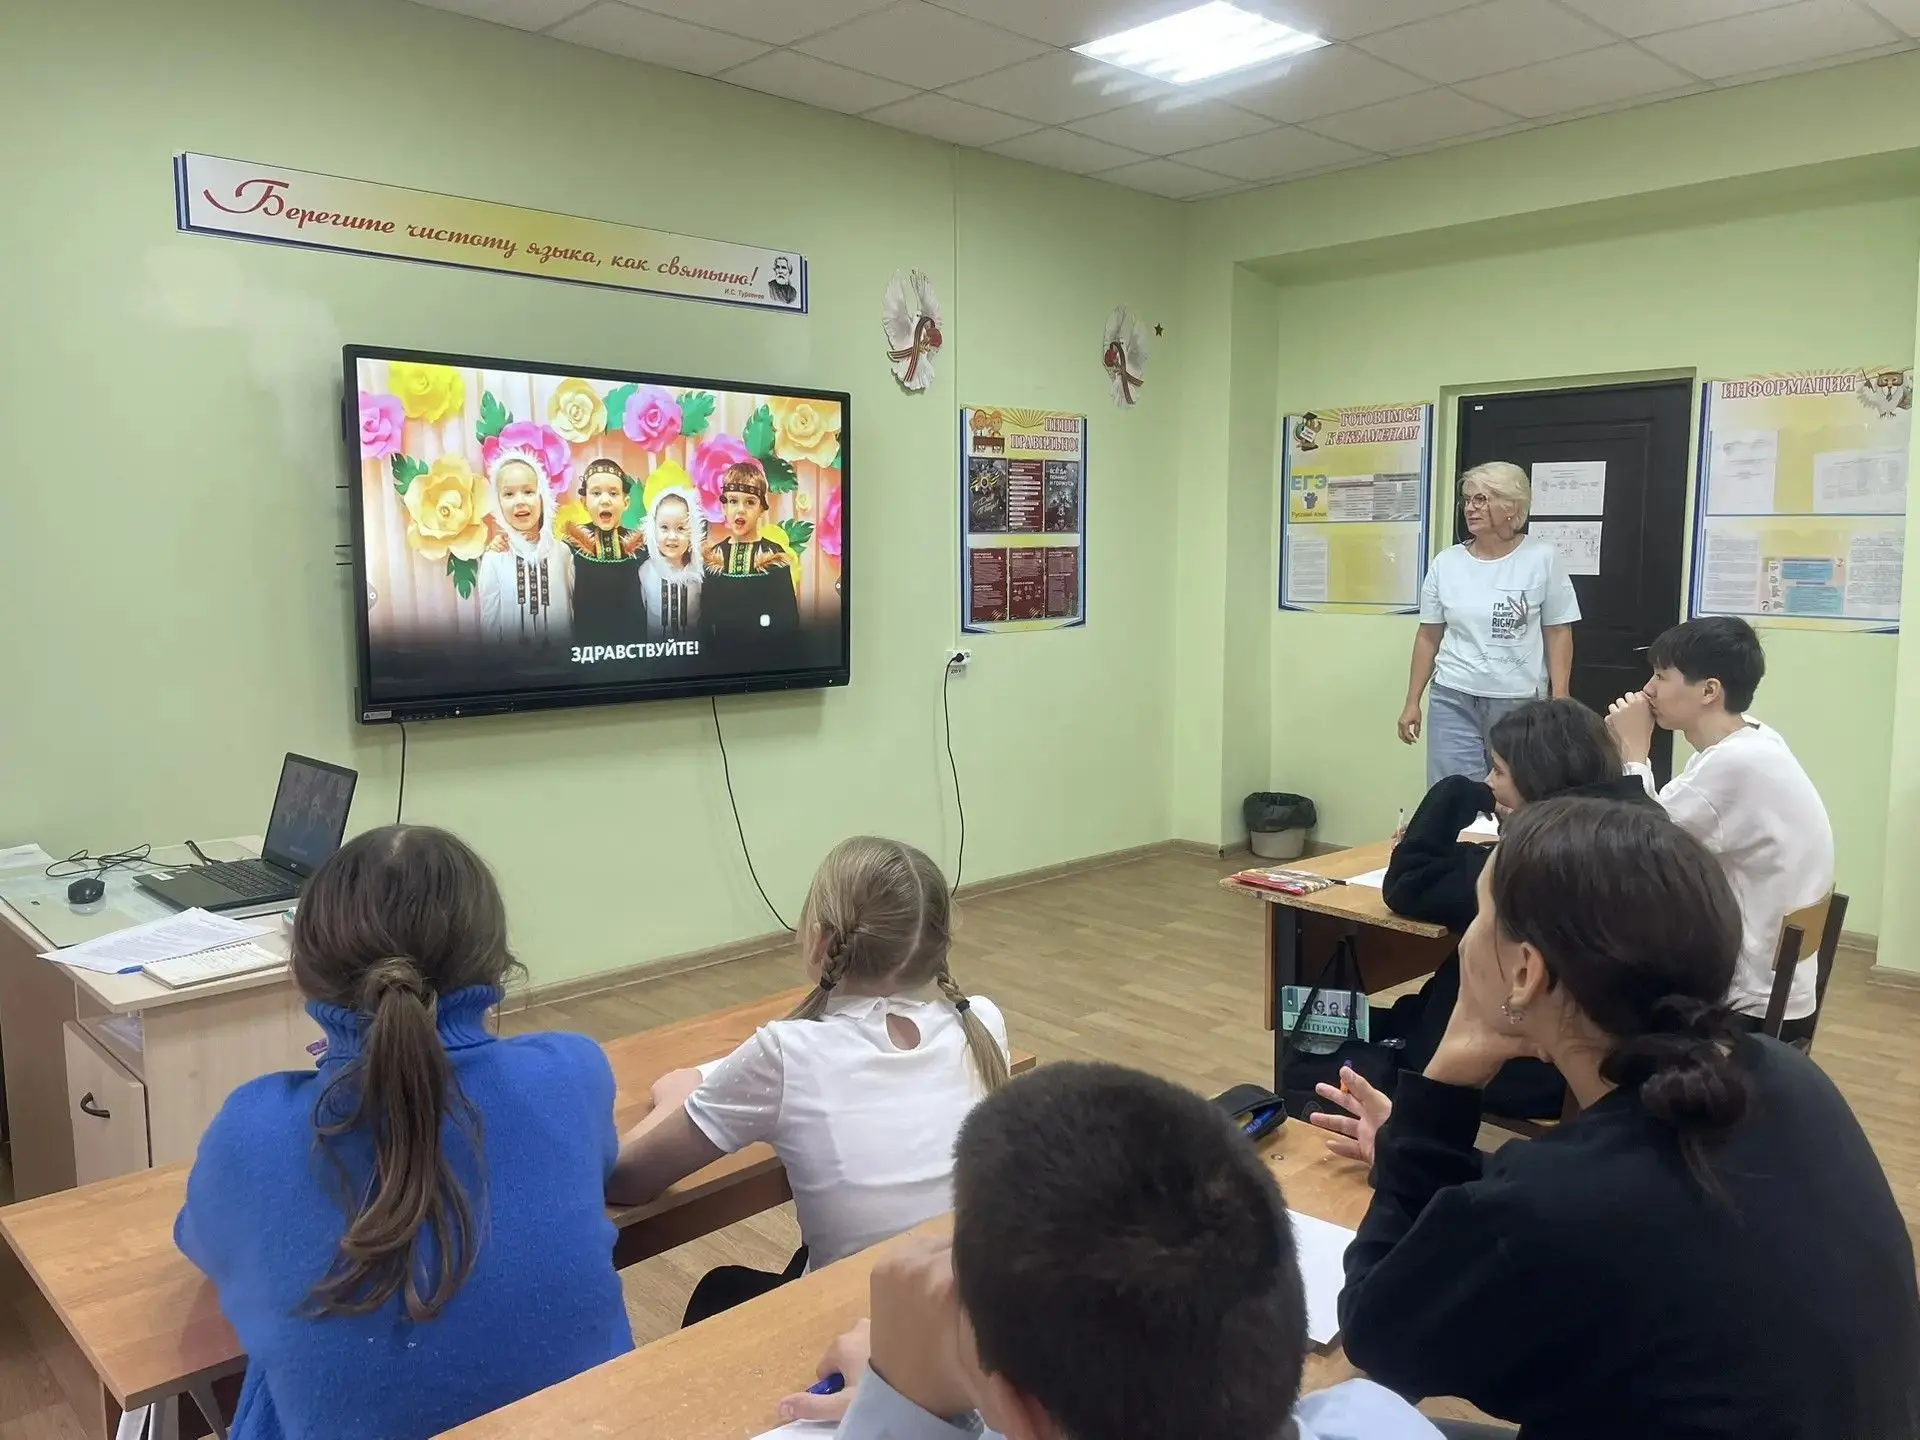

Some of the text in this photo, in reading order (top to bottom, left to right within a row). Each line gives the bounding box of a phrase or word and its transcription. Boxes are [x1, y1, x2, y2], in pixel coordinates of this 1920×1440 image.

[203, 178, 759, 287] Берегите чистоту языка, как святыню!
[1721, 375, 1857, 399] ИНФОРМАЦИЯ
[1340, 407, 1421, 427] ГОТОВИМСЯ
[1010, 433, 1080, 452] ПРАВИЛЬНО!
[1325, 432, 1336, 446] К
[1336, 426, 1420, 445] ЭКЗАМЕНАМ
[1291, 474, 1327, 490] ЕГЭ
[1491, 617, 1515, 628] RIGHT
[571, 638, 699, 664] ЗДРАВСТВУЙТЕ!
